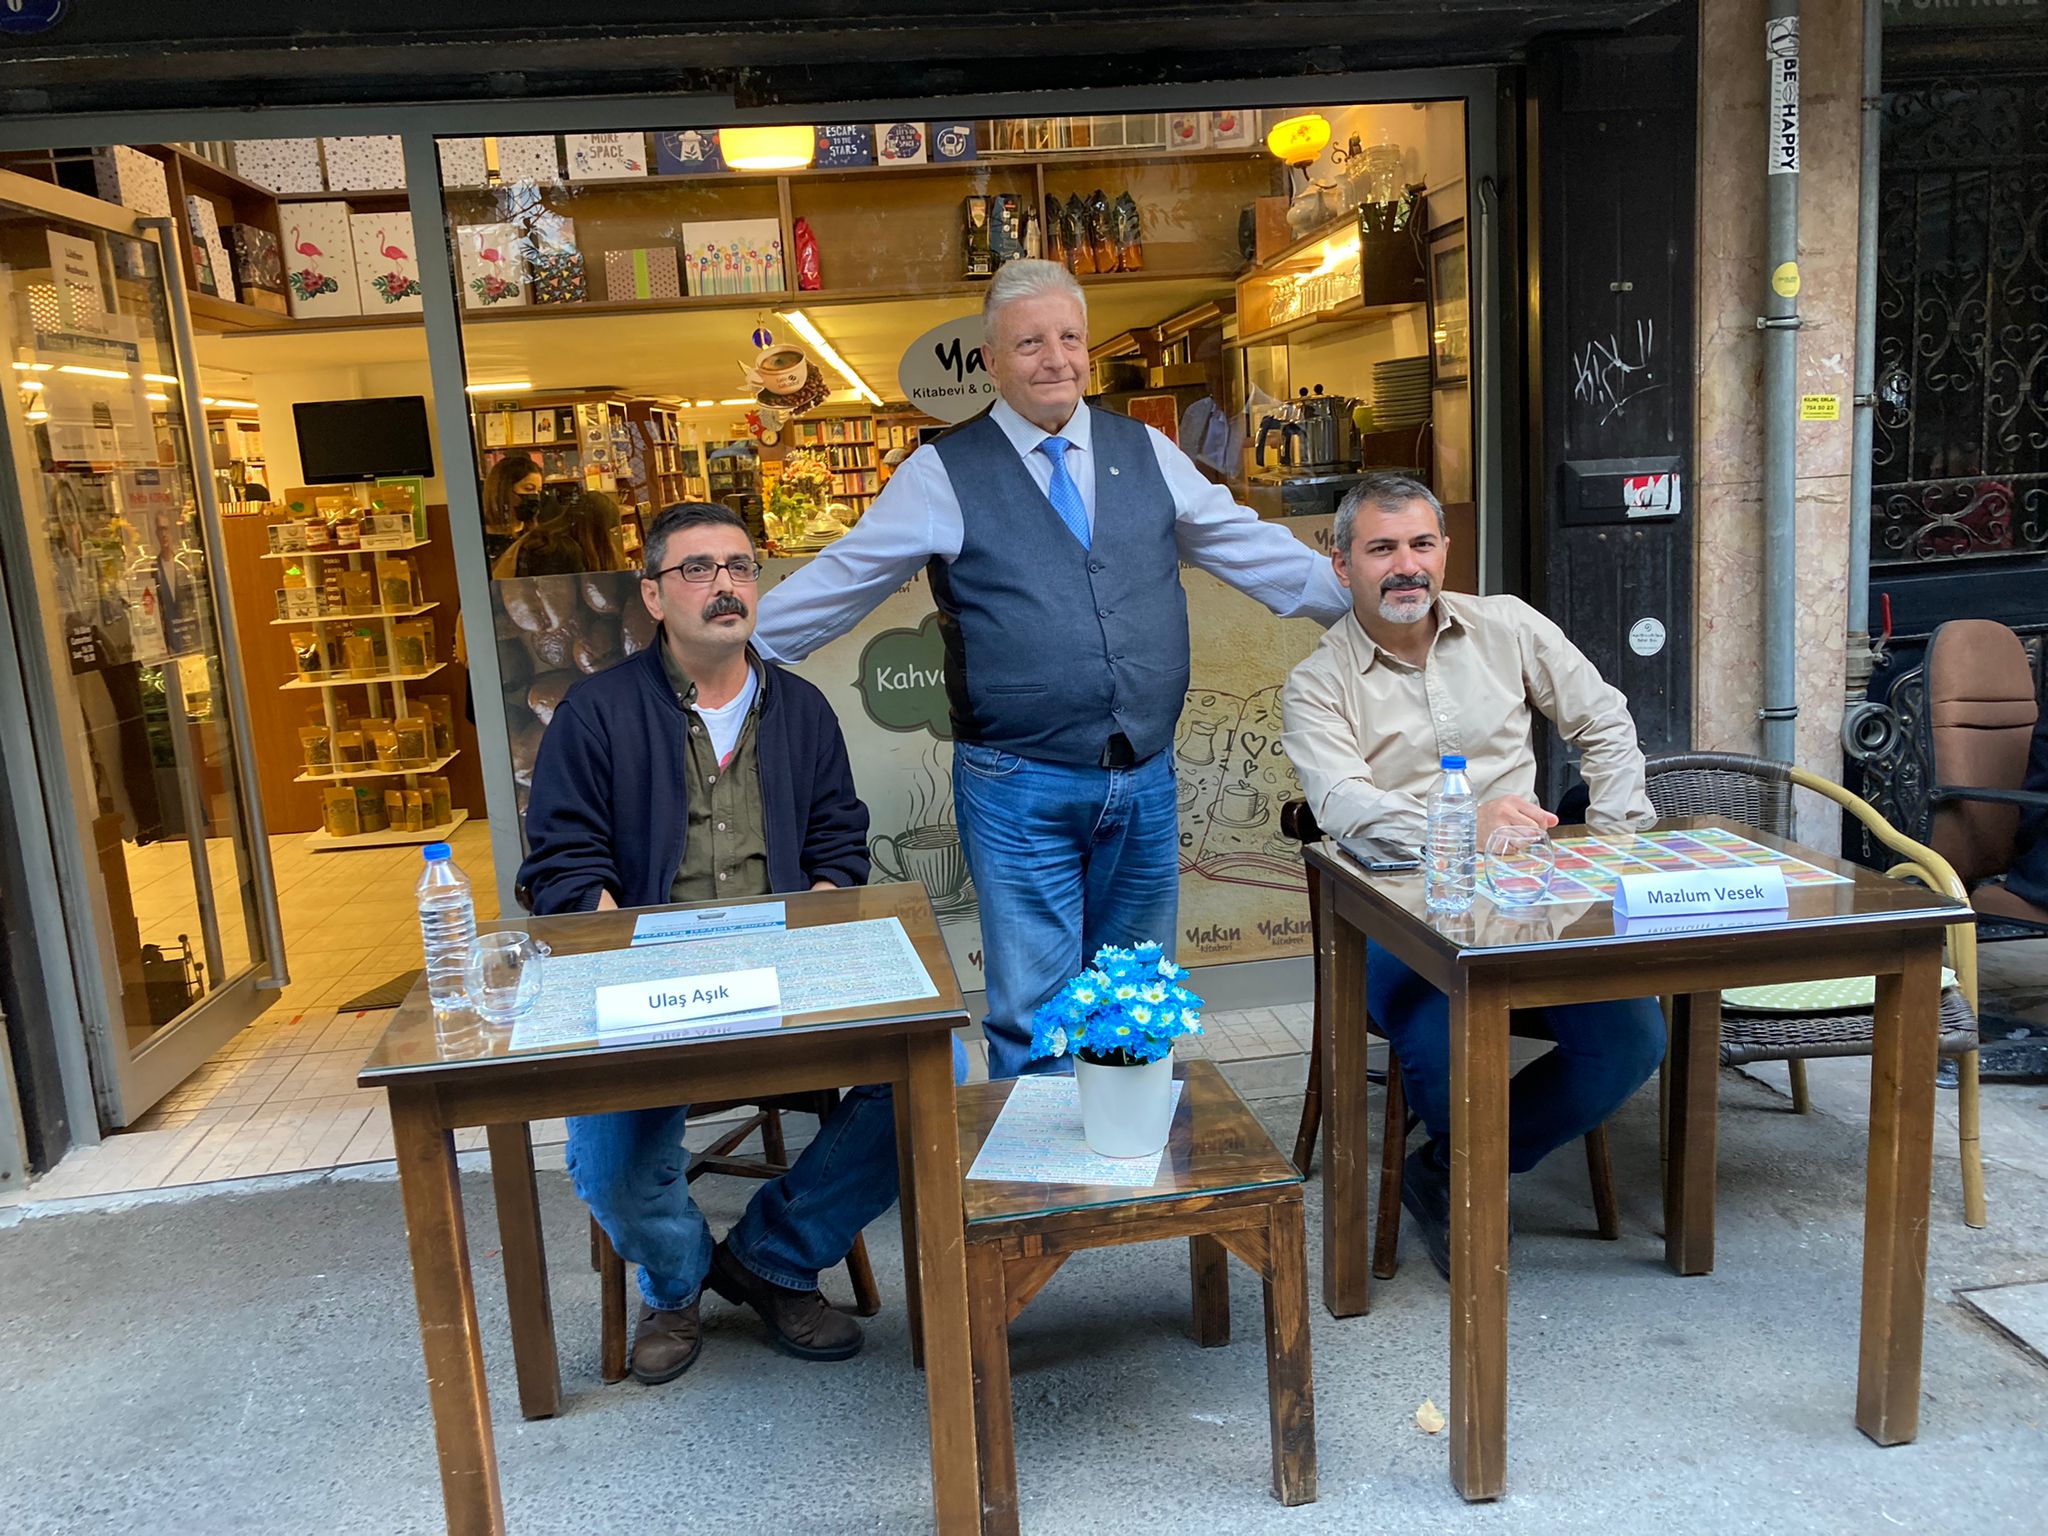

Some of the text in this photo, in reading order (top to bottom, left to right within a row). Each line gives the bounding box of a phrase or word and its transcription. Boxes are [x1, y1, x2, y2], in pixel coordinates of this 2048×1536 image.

[1784, 59, 1797, 82] BE
[591, 133, 619, 144] MORE
[826, 125, 857, 137] ESCAPE
[1781, 105, 1796, 170] HAPPY
[590, 145, 624, 158] SPACE
[829, 144, 857, 157] STARS
[913, 385, 964, 399] Kitabevi
[969, 384, 977, 394] &
[1647, 885, 1764, 904] Mazlum Vesek
[649, 985, 729, 1008] Ulaş Aşık
